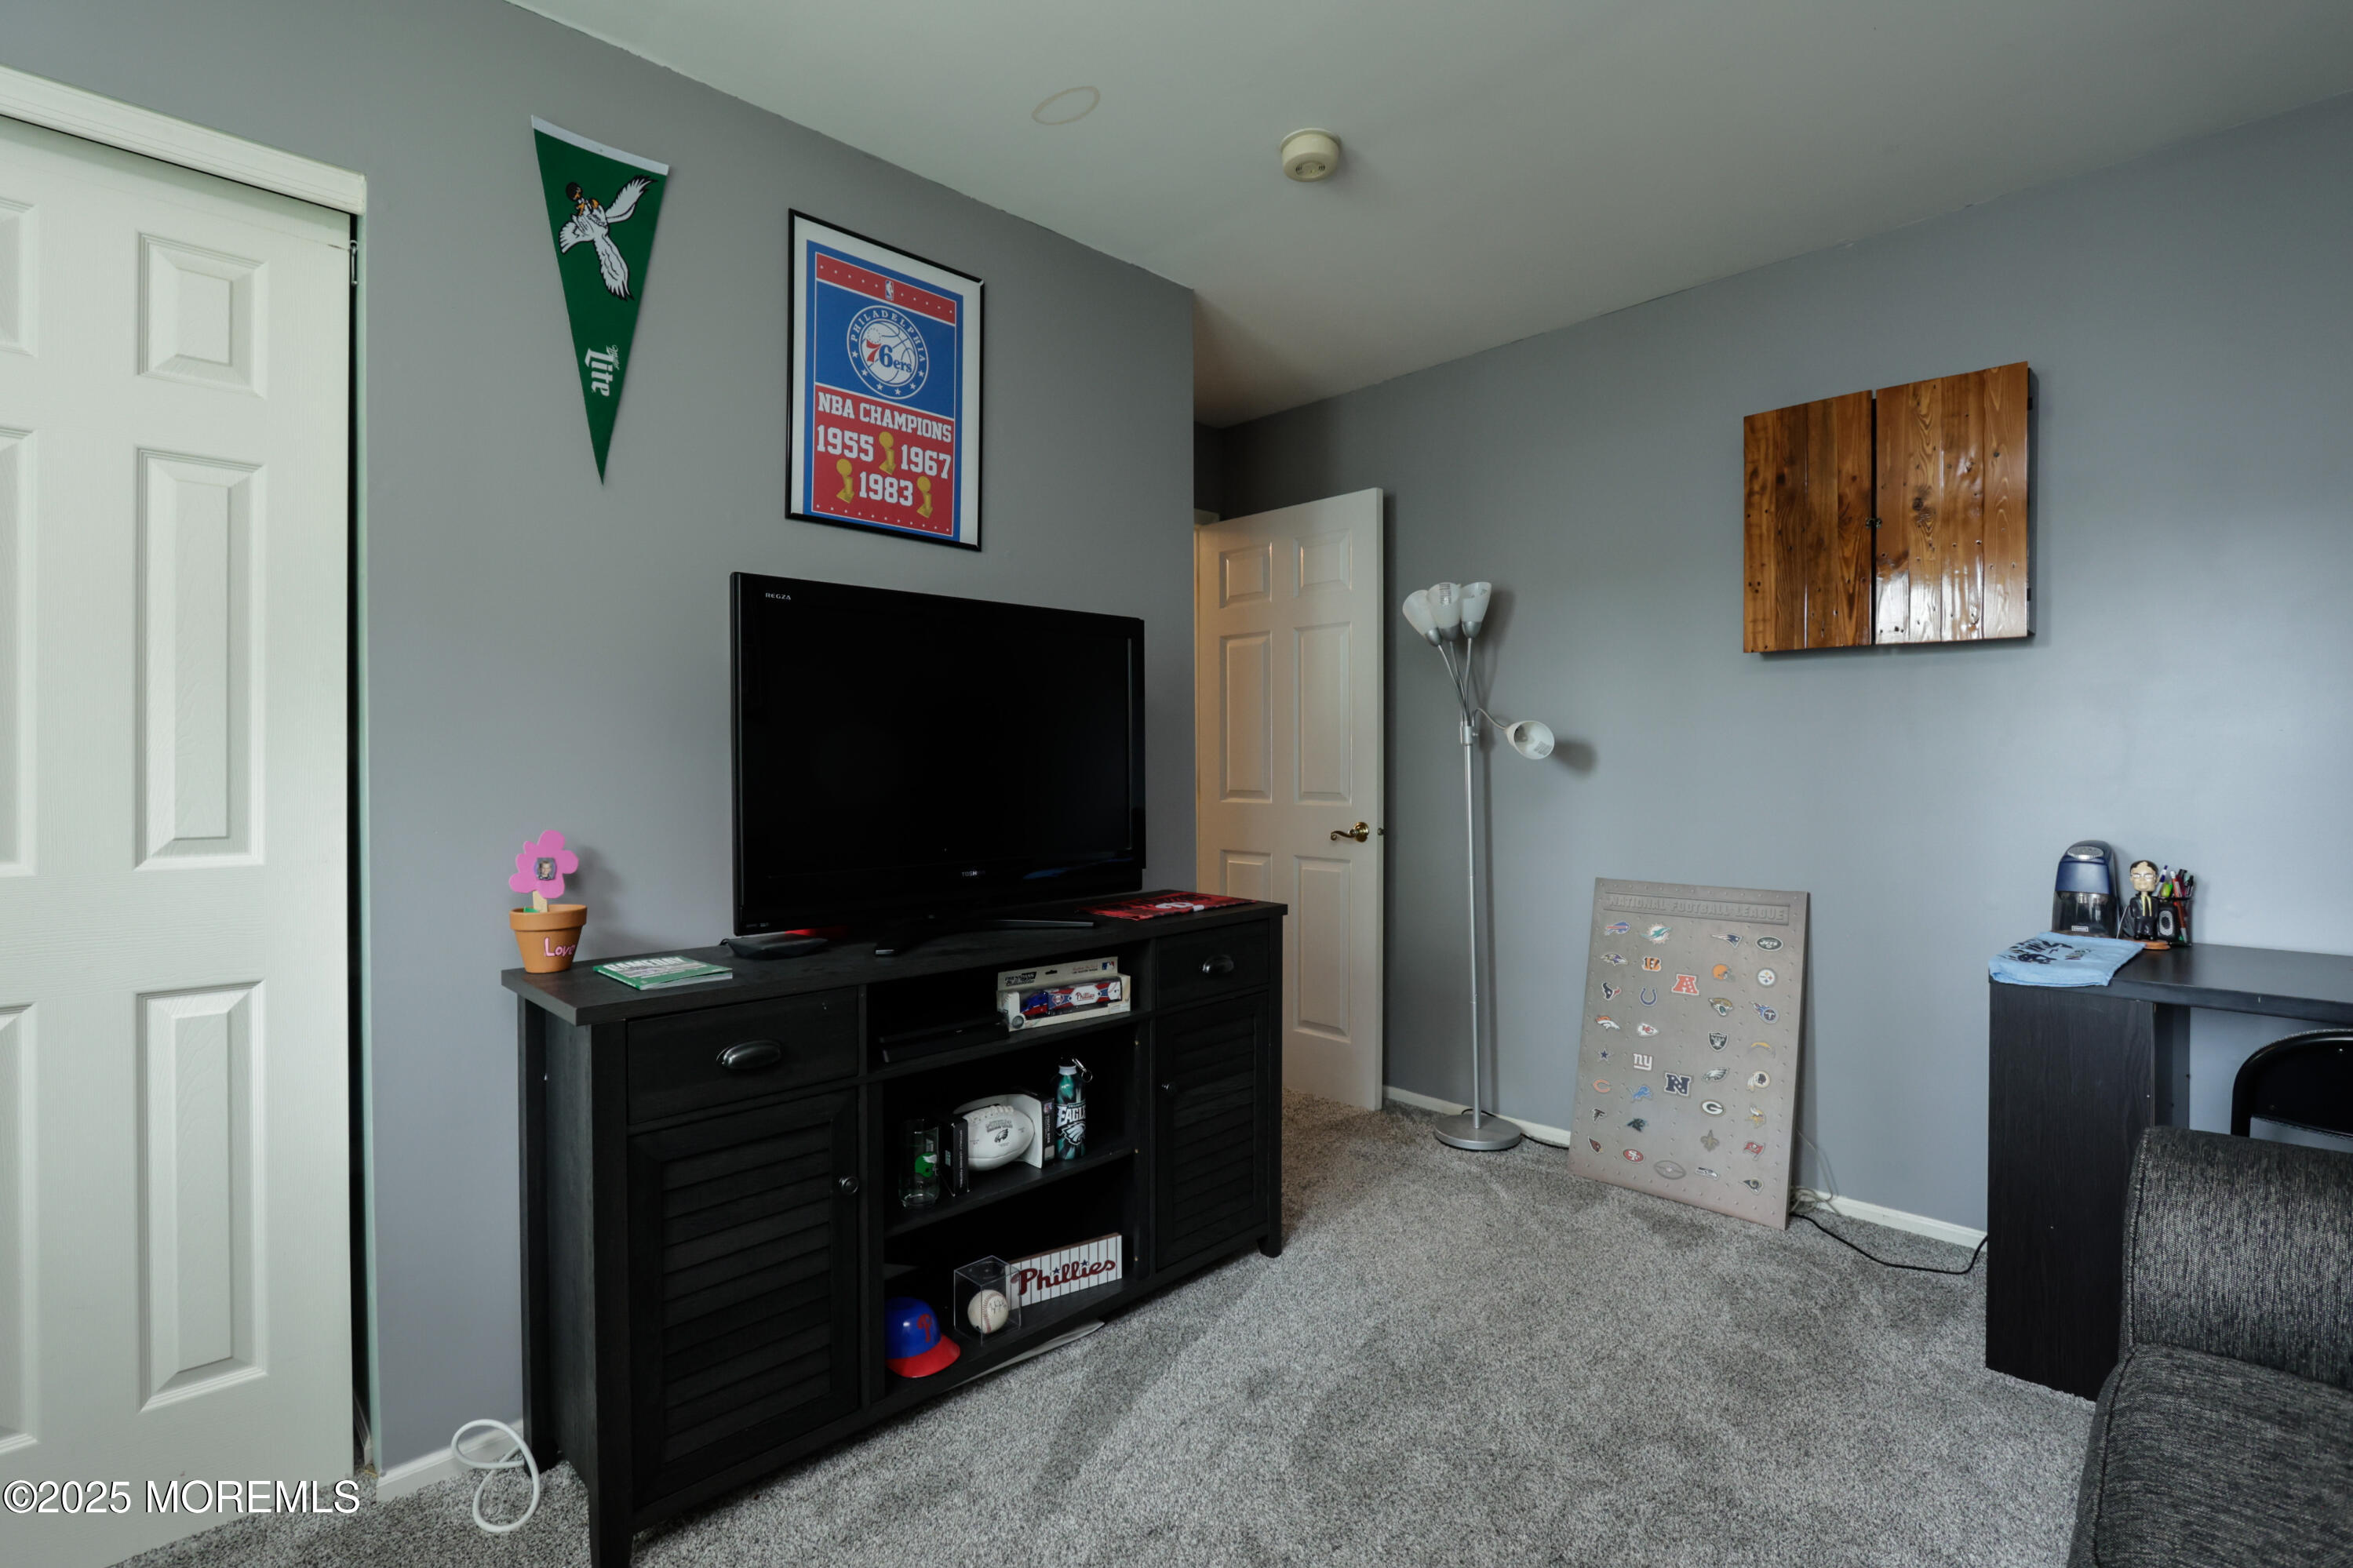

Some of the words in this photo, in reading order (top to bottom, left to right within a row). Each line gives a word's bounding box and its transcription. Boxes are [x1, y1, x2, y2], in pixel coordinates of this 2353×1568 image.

[851, 309, 926, 362] PHILADELPHIA
[585, 347, 614, 397] Lite
[865, 339, 912, 373] 76ers
[818, 391, 855, 420] NBA
[859, 402, 952, 443] CHAMPIONS
[817, 424, 874, 462] 1955
[901, 444, 952, 479] 1967
[859, 471, 913, 507] 1983
[1607, 896, 1666, 911] NATIONAL
[1670, 900, 1730, 916] FOOTBALL
[1735, 904, 1784, 920] LEAGUE
[544, 937, 576, 957] Love
[1011, 1259, 1116, 1295] Phillies
[917, 1313, 932, 1343] P
